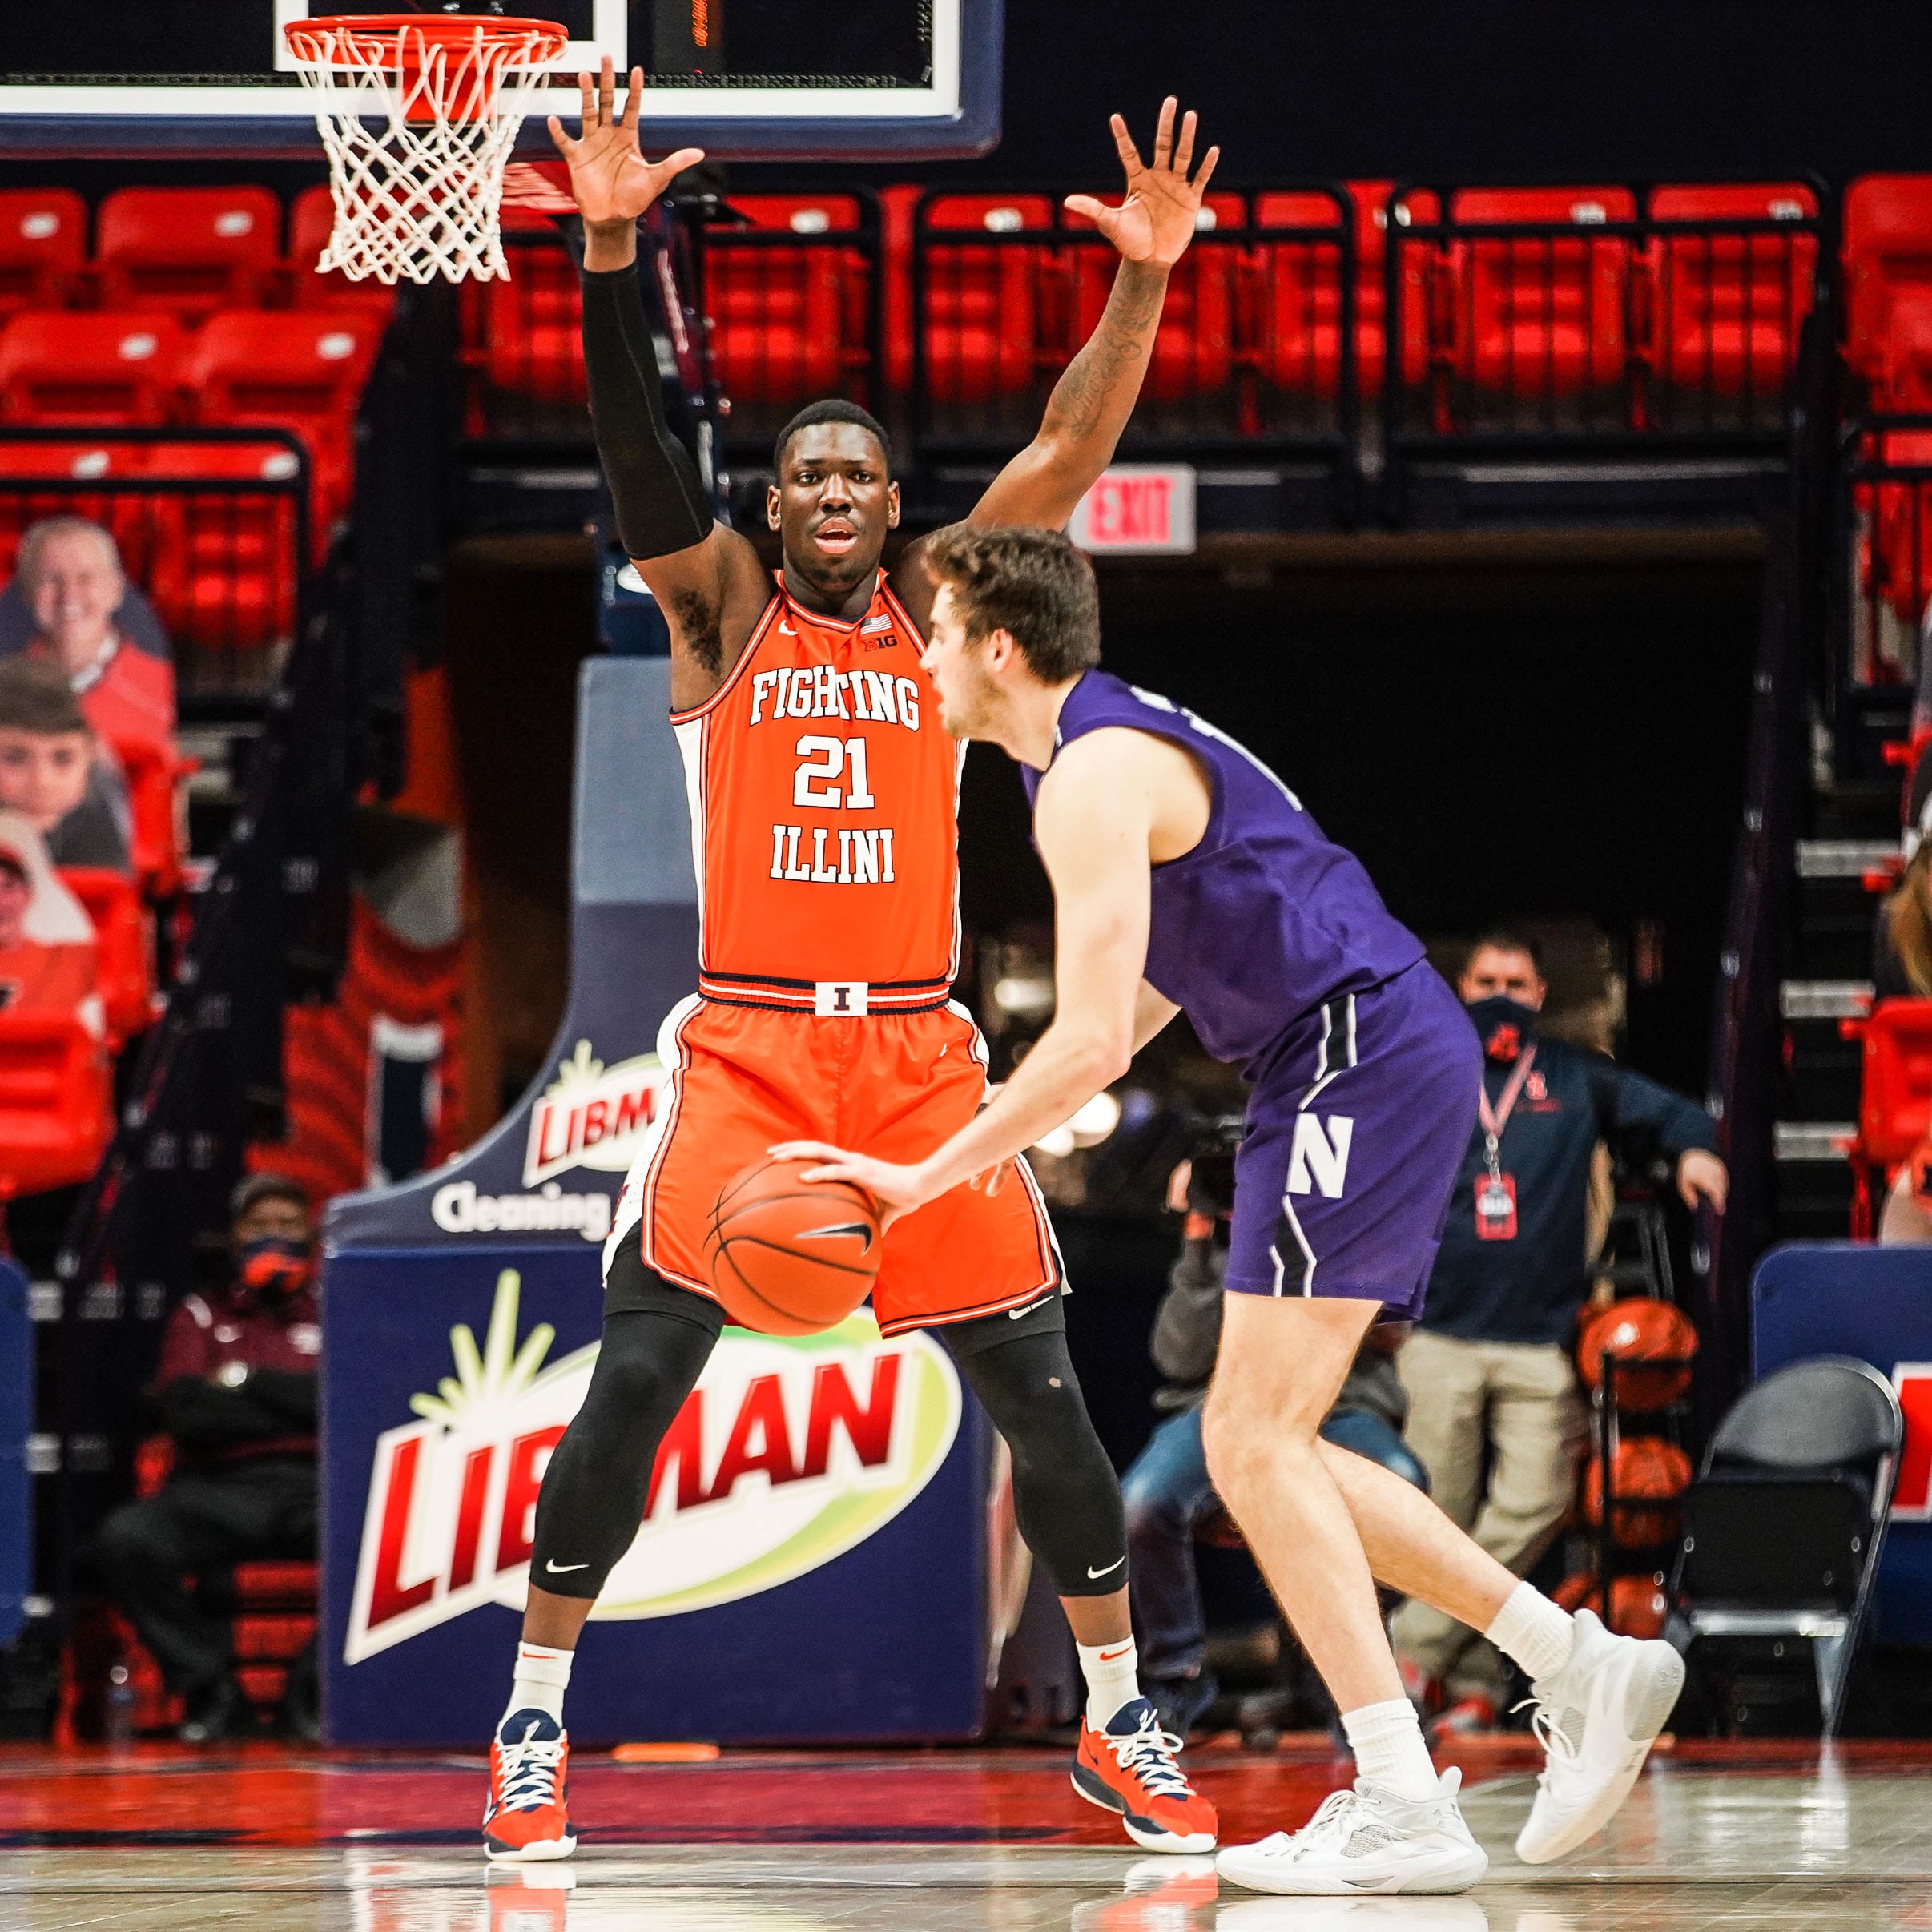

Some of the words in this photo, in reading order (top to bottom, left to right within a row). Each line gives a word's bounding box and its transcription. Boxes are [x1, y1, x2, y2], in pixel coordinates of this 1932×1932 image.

[750, 665, 920, 732] FIGHTING
[792, 735, 875, 810] 21
[769, 824, 896, 884] ILLINI
[1285, 1112, 1355, 1199] N
[431, 1181, 611, 1242] Cleaning
